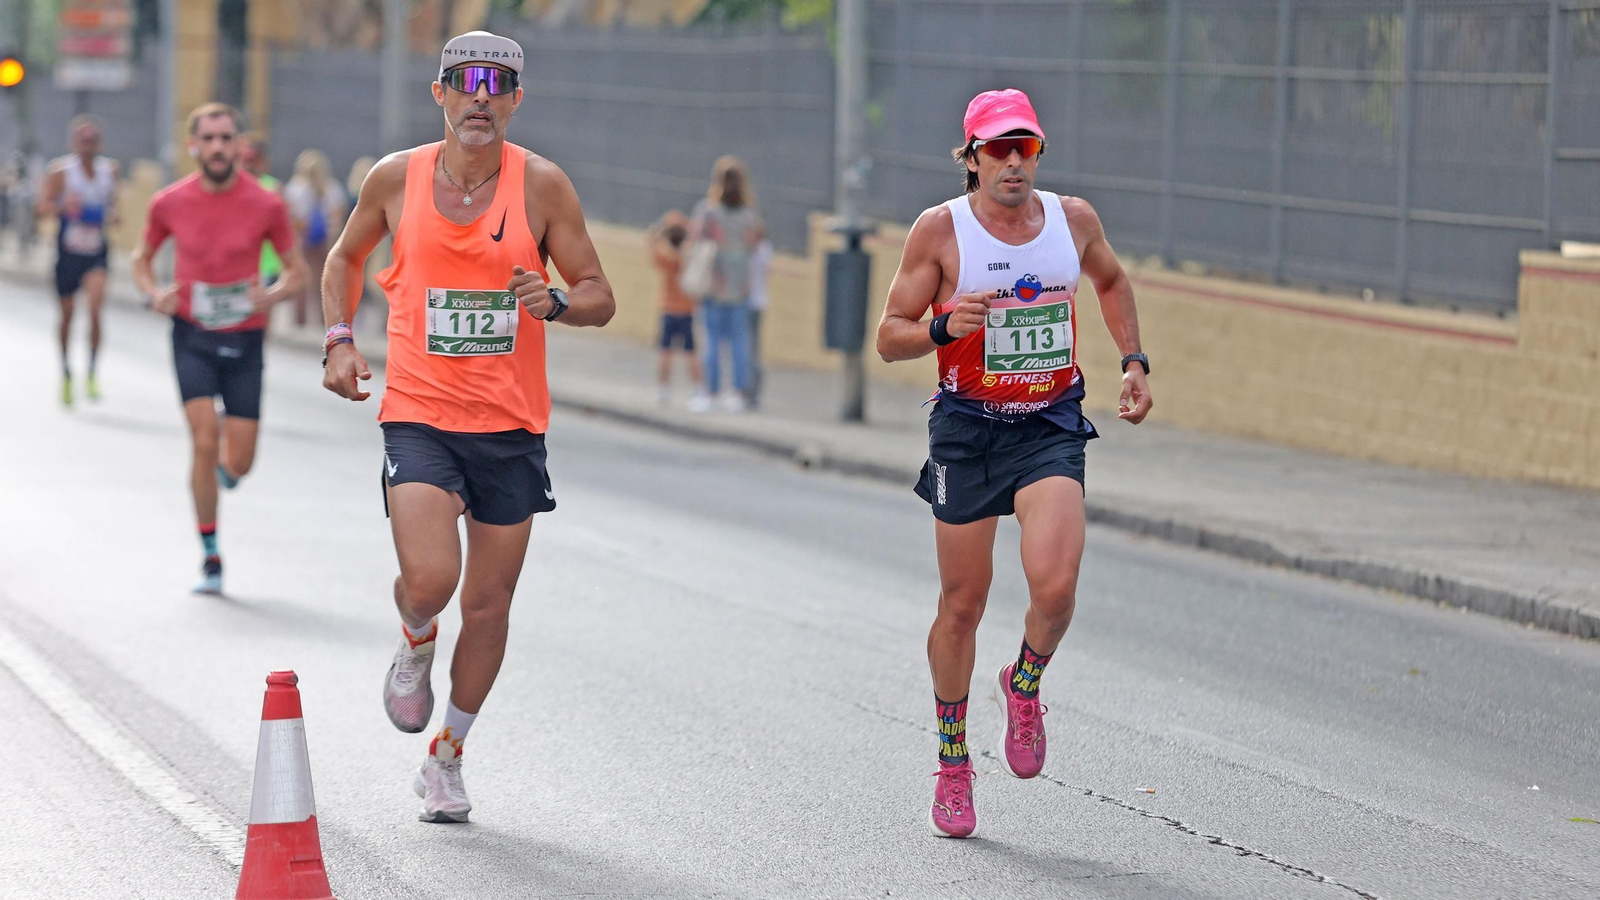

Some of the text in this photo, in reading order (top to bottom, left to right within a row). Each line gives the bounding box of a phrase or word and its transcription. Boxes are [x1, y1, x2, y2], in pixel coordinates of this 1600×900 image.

[444, 48, 523, 59] NIKE TRAIL
[988, 262, 1011, 271] GOBIK
[1040, 285, 1066, 293] man
[449, 312, 495, 335] 112
[1012, 316, 1035, 326] XXIX
[1010, 327, 1054, 352] 113
[999, 372, 1054, 385] FITNESS
[1020, 669, 1035, 682] QUE
